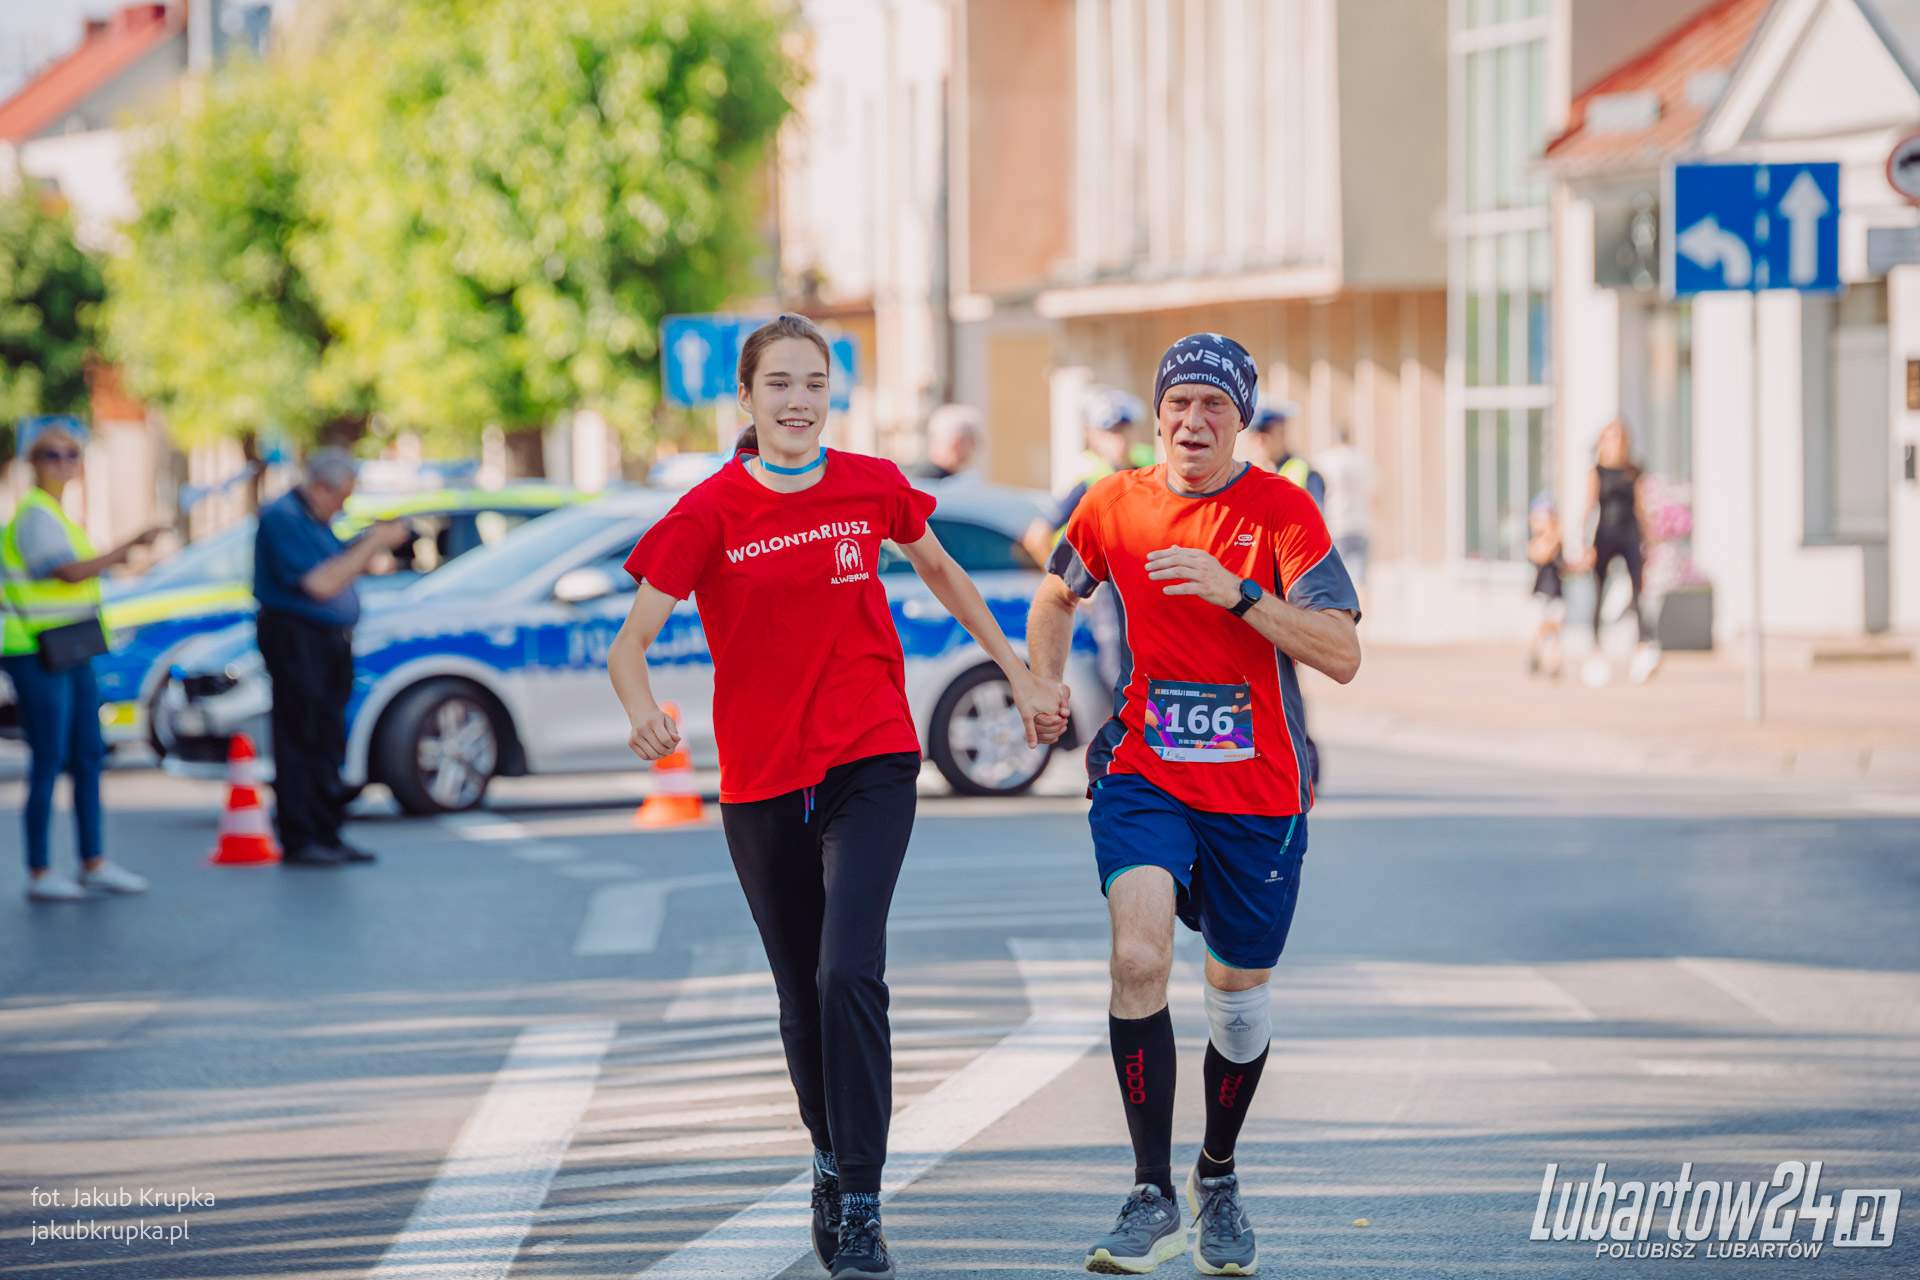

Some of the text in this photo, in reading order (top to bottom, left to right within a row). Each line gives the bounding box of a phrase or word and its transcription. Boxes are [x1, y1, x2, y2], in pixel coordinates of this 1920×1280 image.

[1162, 348, 1250, 404] LWERNIA
[726, 521, 871, 564] WOLONTARIUSZ
[1165, 703, 1234, 736] 166
